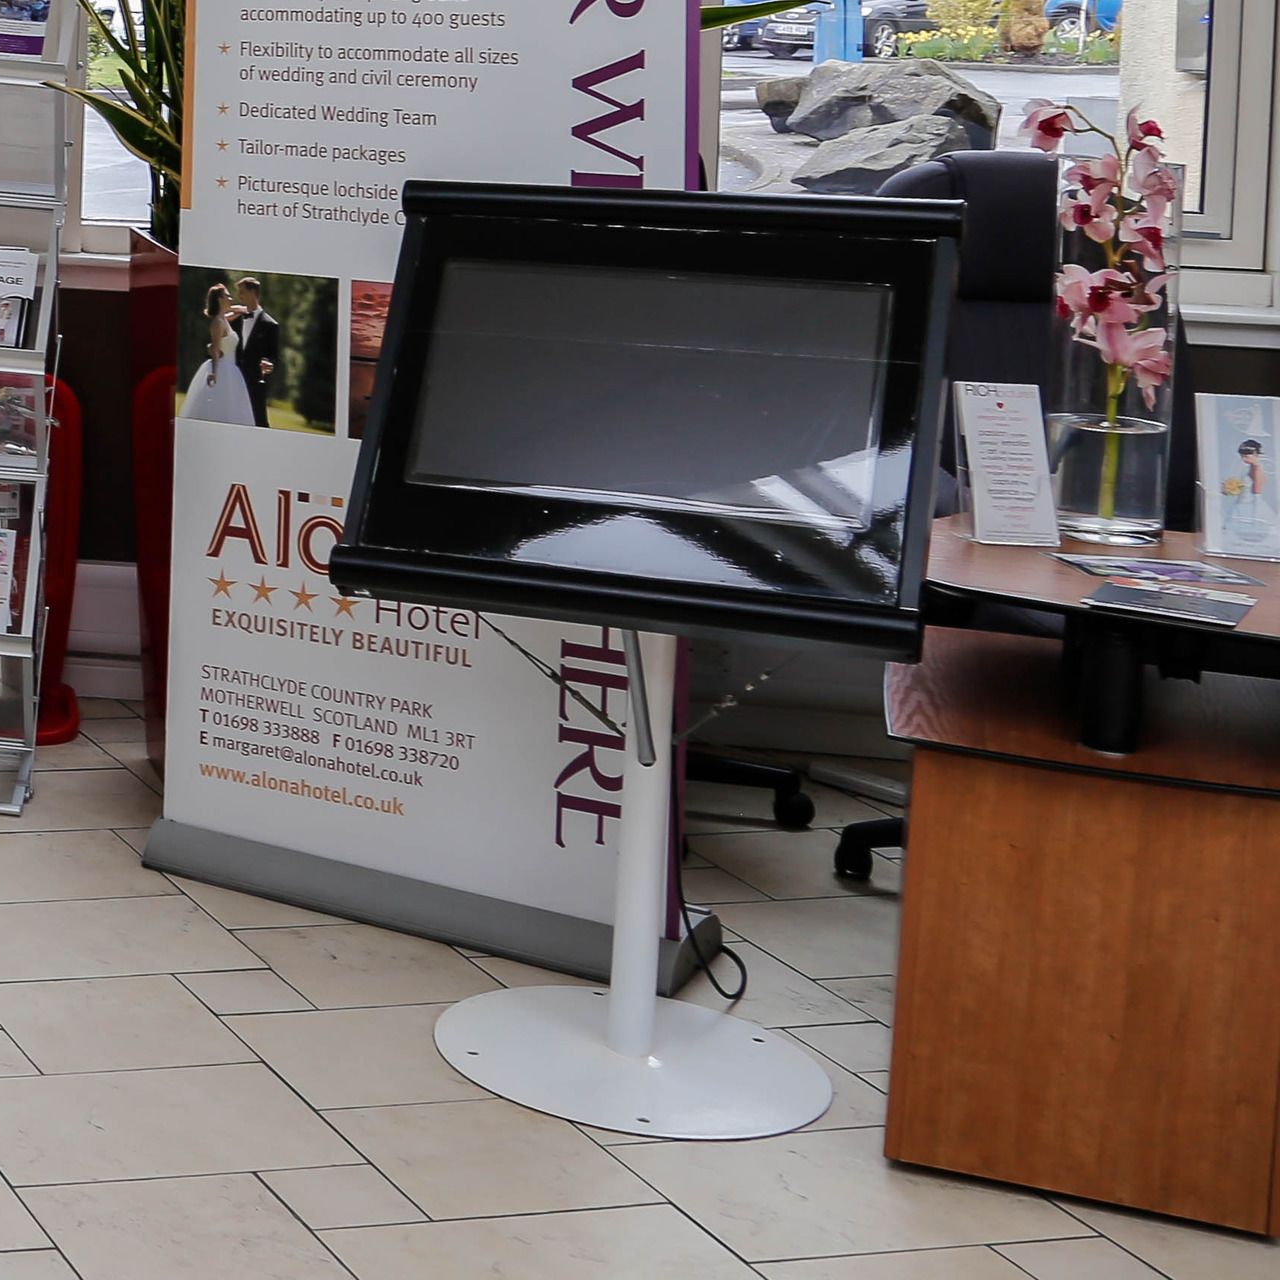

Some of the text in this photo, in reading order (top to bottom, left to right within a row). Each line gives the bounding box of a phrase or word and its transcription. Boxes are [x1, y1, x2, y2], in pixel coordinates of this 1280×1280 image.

[240, 7, 505, 30] accommodating up to 400 guests
[240, 40, 519, 65] Flexibility to accommodate all sizes
[240, 64, 478, 92] of wedding and civil ceremony
[240, 101, 436, 128] Dedicated Wedding Team
[238, 138, 406, 166] Tailor-made packages
[238, 175, 398, 200] Picturesque lochside
[237, 199, 278, 216] heart
[282, 201, 299, 217] of
[302, 202, 389, 226] Strathclyde
[212, 608, 472, 668] EXQUISITELY BEAUTIFUL
[201, 665, 432, 719] STRATHCLYDE COUNTRY PARK
[201, 687, 476, 749] MOTHERWELL SCOTLAND ML1 3RT
[199, 707, 459, 770] T 01698 333888 F 01698 338720
[200, 730, 423, 787] E margaret@alonahotel.co.uk
[199, 762, 405, 816] www.alonahotel.co.uk
